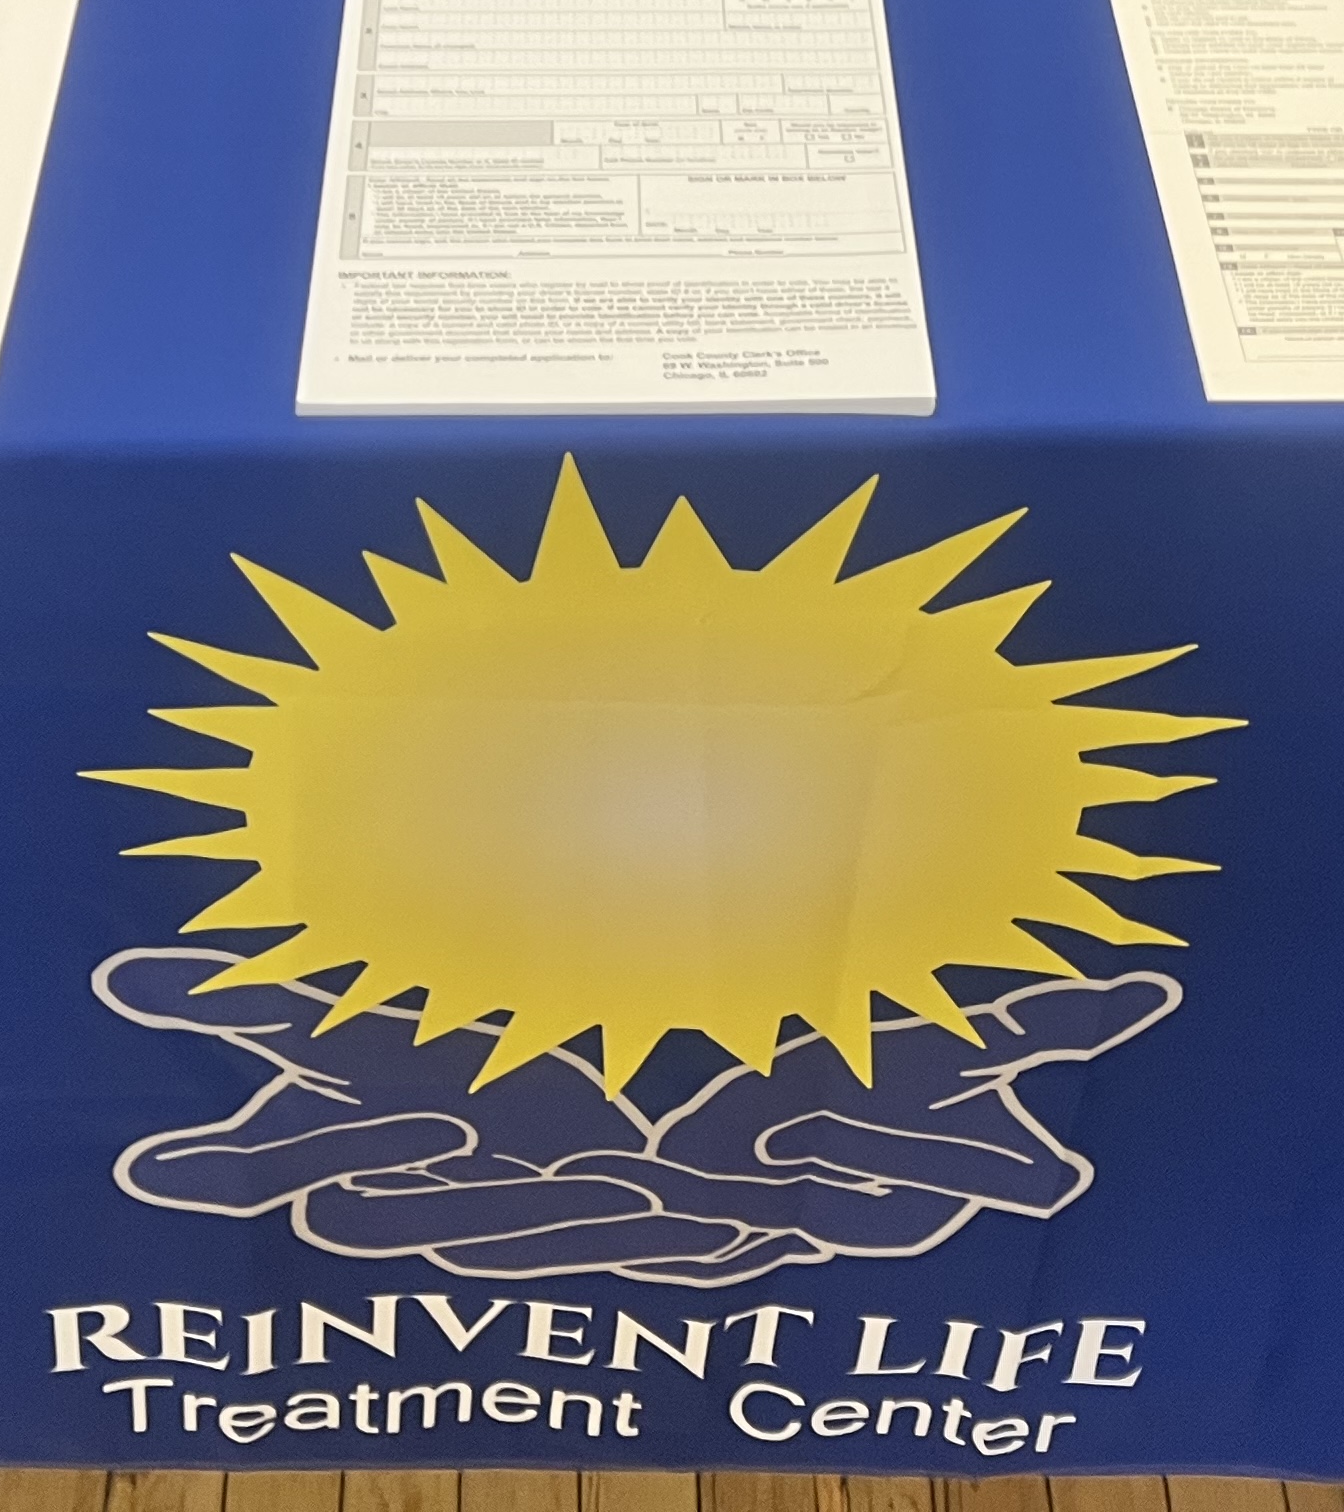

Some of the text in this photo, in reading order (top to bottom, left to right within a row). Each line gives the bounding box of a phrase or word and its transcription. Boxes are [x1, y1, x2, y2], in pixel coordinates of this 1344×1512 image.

[696, 350, 739, 364] County
[786, 347, 821, 359] Office
[47, 1292, 1150, 1393] REINVENT LIFE
[103, 1375, 1077, 1458] Treatment Center
